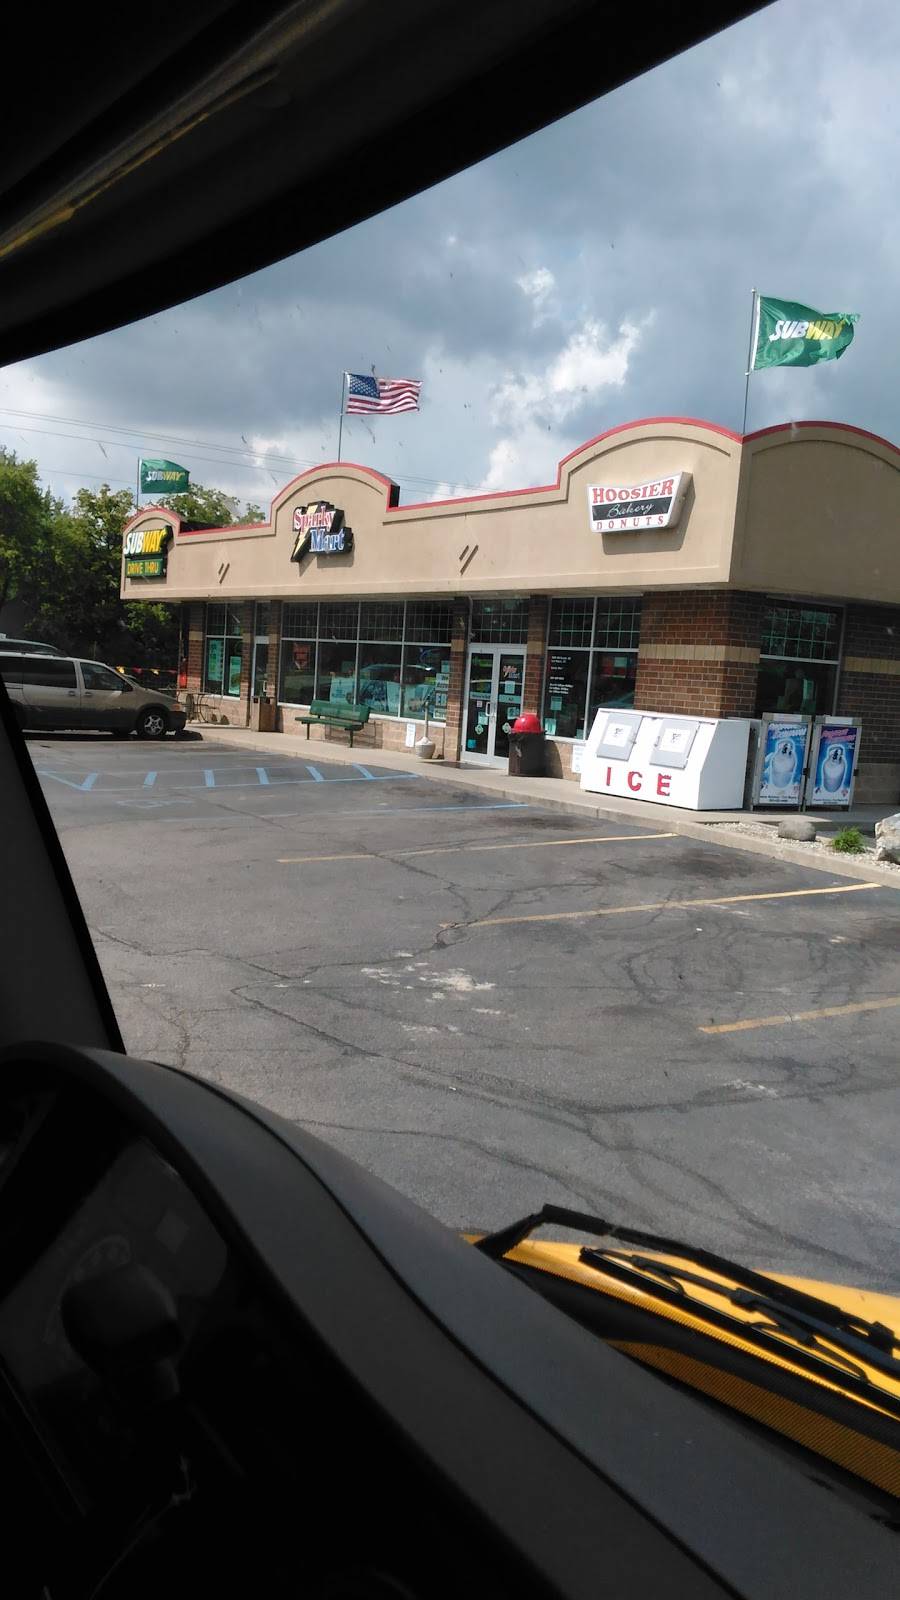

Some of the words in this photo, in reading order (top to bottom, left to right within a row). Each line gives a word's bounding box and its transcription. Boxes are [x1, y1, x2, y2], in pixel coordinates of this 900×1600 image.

[768, 319, 845, 342] SUBWAY
[146, 470, 185, 482] SUBWAY
[592, 479, 674, 504] HOOSIER
[293, 505, 336, 533] Sparky
[607, 503, 654, 518] Bakery
[596, 516, 664, 531] DONUTS
[123, 528, 168, 555] SUBWAY
[309, 528, 345, 552] Mart
[127, 562, 143, 574] DRIVE
[145, 561, 159, 573] THRU
[606, 766, 672, 797] ICE
